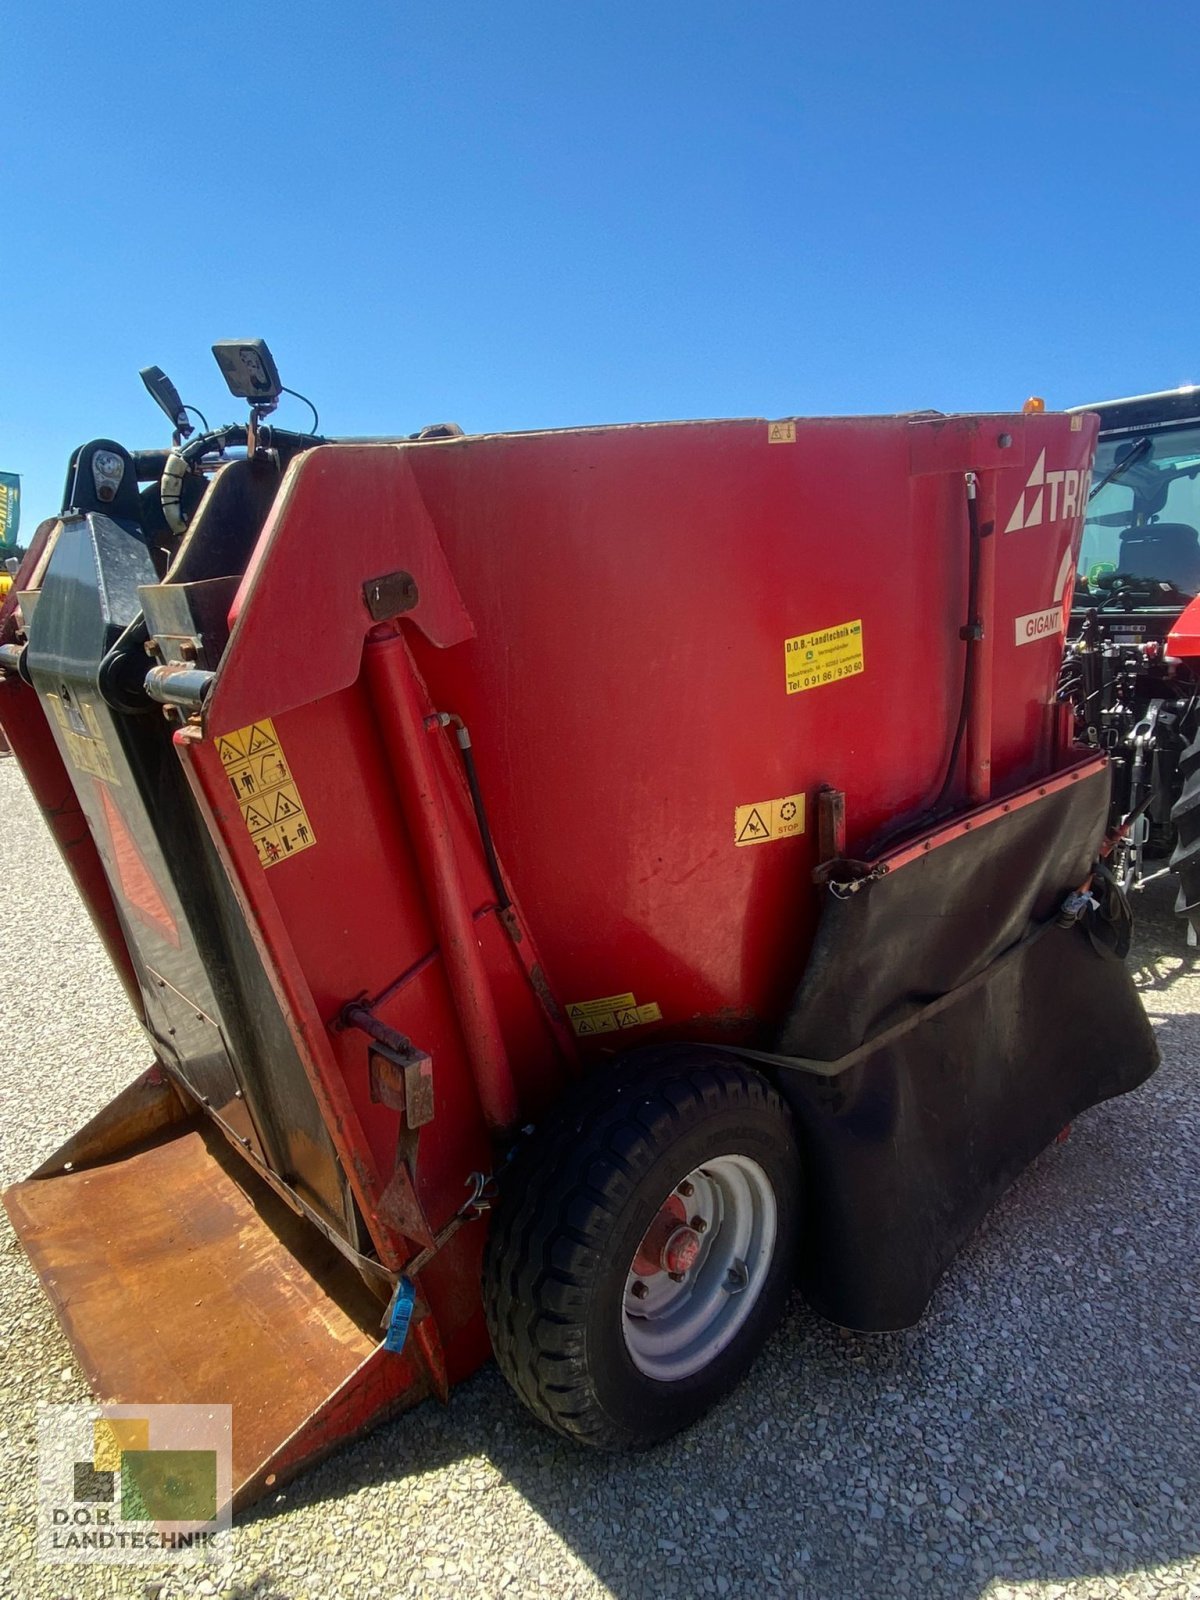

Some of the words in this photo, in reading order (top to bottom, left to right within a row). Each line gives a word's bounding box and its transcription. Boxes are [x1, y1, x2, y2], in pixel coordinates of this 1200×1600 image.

[1026, 611, 1060, 637] GIGANT
[786, 627, 849, 653] D.O.B.-Landtechnik
[788, 681, 802, 691] Tel.
[804, 678, 810, 686] 0
[811, 674, 820, 685] 91
[823, 671, 832, 681] 86
[838, 668, 843, 677] 9
[844, 665, 853, 675] 30
[854, 661, 862, 671] 60
[778, 823, 799, 833] STOP
